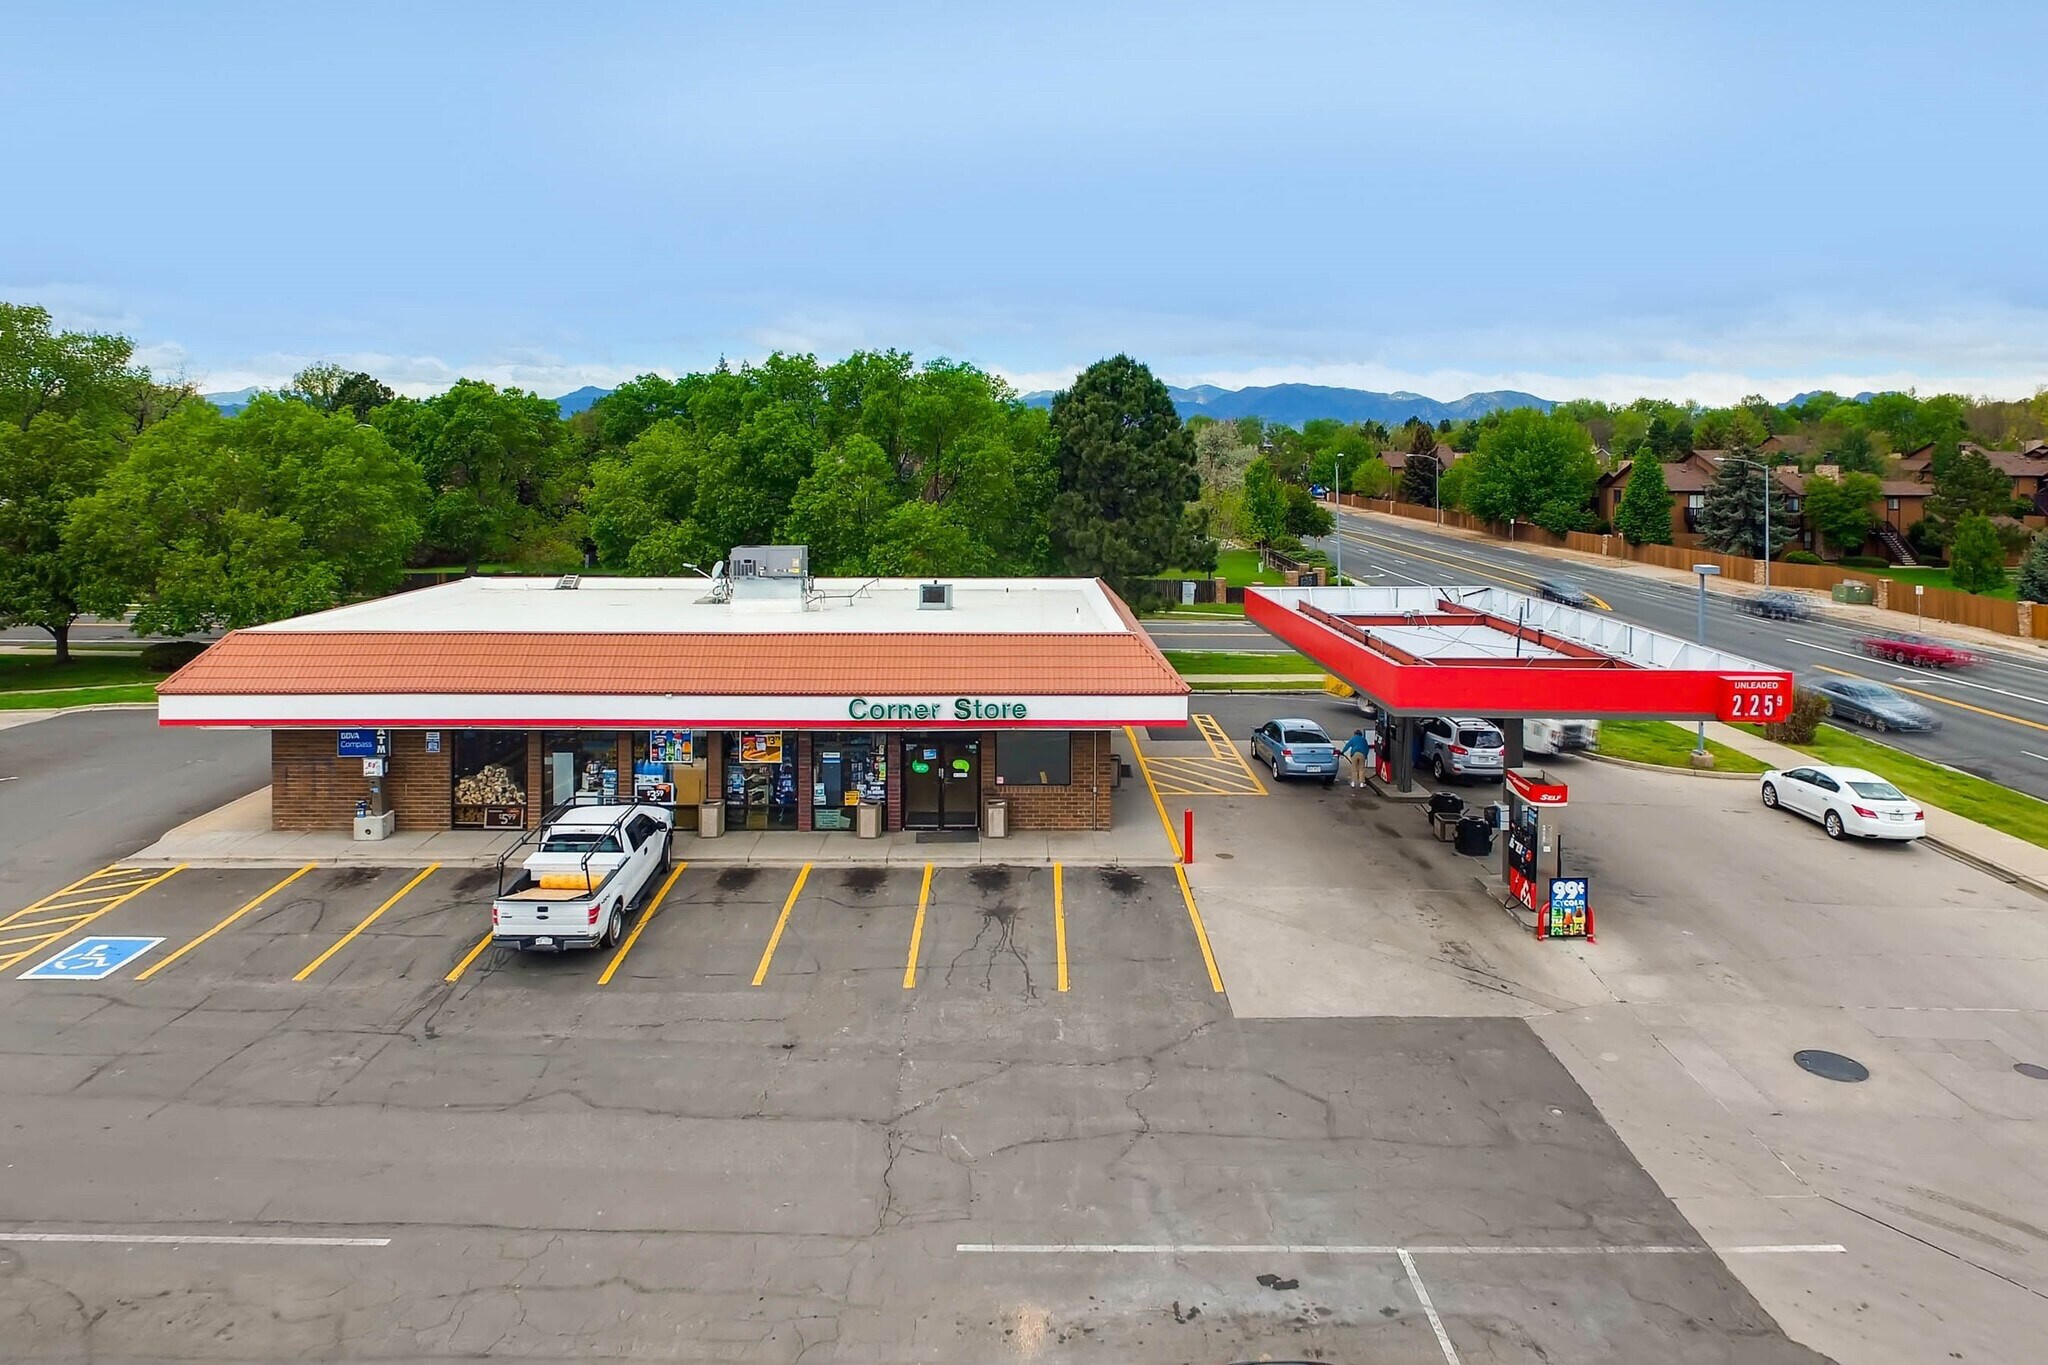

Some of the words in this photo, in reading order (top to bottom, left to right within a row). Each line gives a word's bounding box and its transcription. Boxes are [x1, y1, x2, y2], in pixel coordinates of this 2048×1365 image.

[1734, 681, 1779, 689] UNLEADED
[849, 698, 940, 719] Corner
[954, 698, 1027, 719] Store
[340, 740, 373, 748] Compass
[1552, 881, 1585, 900] 99¢
